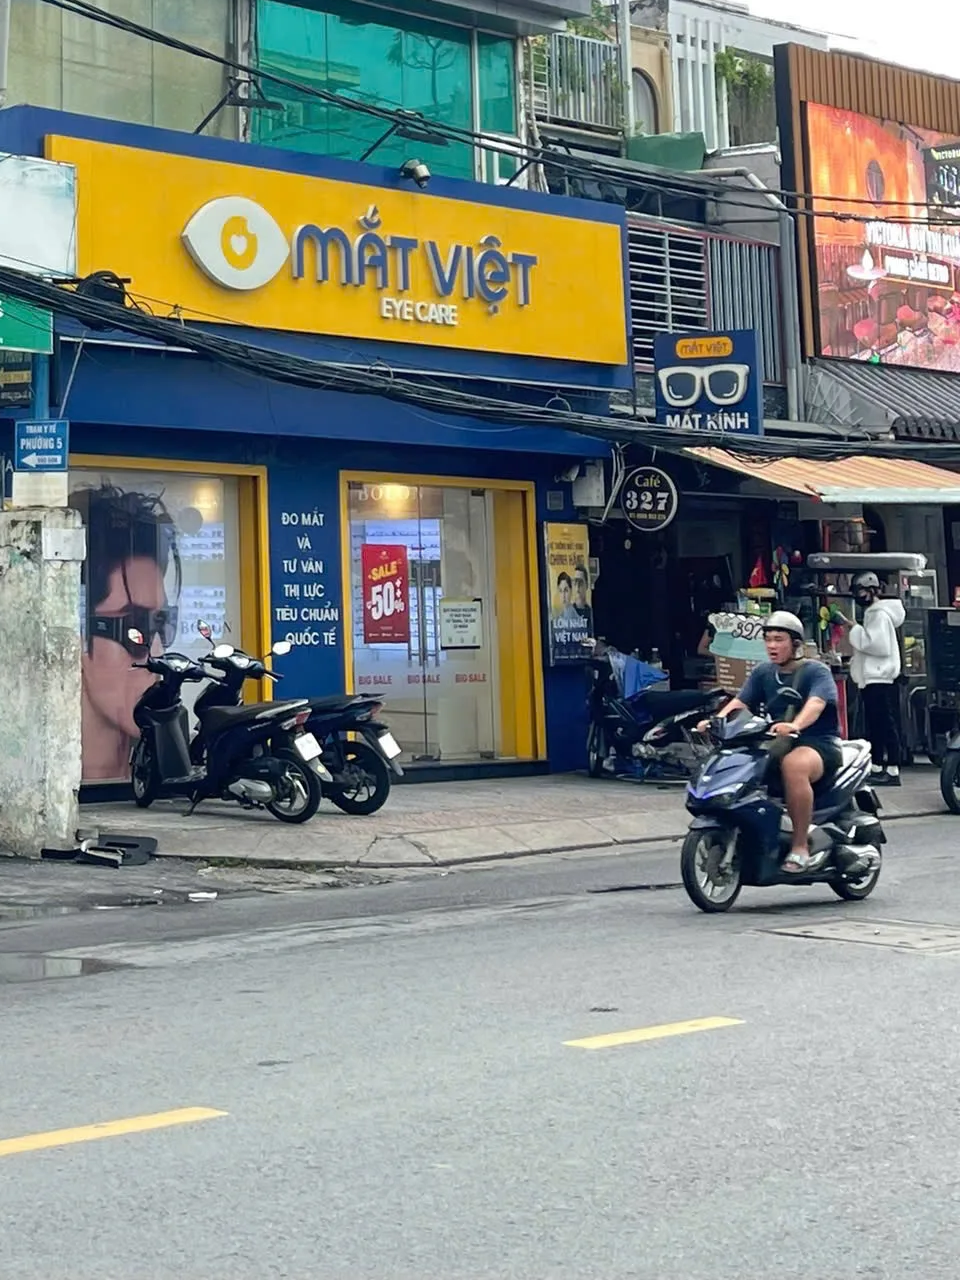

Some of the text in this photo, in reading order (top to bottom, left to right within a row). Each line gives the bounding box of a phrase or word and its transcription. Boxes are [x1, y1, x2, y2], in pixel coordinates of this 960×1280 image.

[381, 296, 458, 326] EYE CARE
[707, 408, 749, 430] KÍNH
[57, 437, 63, 449] 5
[635, 475, 661, 487] Café
[626, 490, 670, 510] 327
[281, 506, 324, 526] ĐO MẮT
[297, 533, 312, 549] VÀ
[283, 558, 297, 573] TƯ
[371, 561, 398, 581] SALE
[284, 582, 324, 600] THỊ LỰC
[276, 605, 297, 621] TIÊU
[285, 626, 336, 645] QUỐC TẾ
[358, 675, 392, 685] BIG SALE
[407, 674, 420, 684] BIG
[455, 673, 487, 683] BIG SALE
